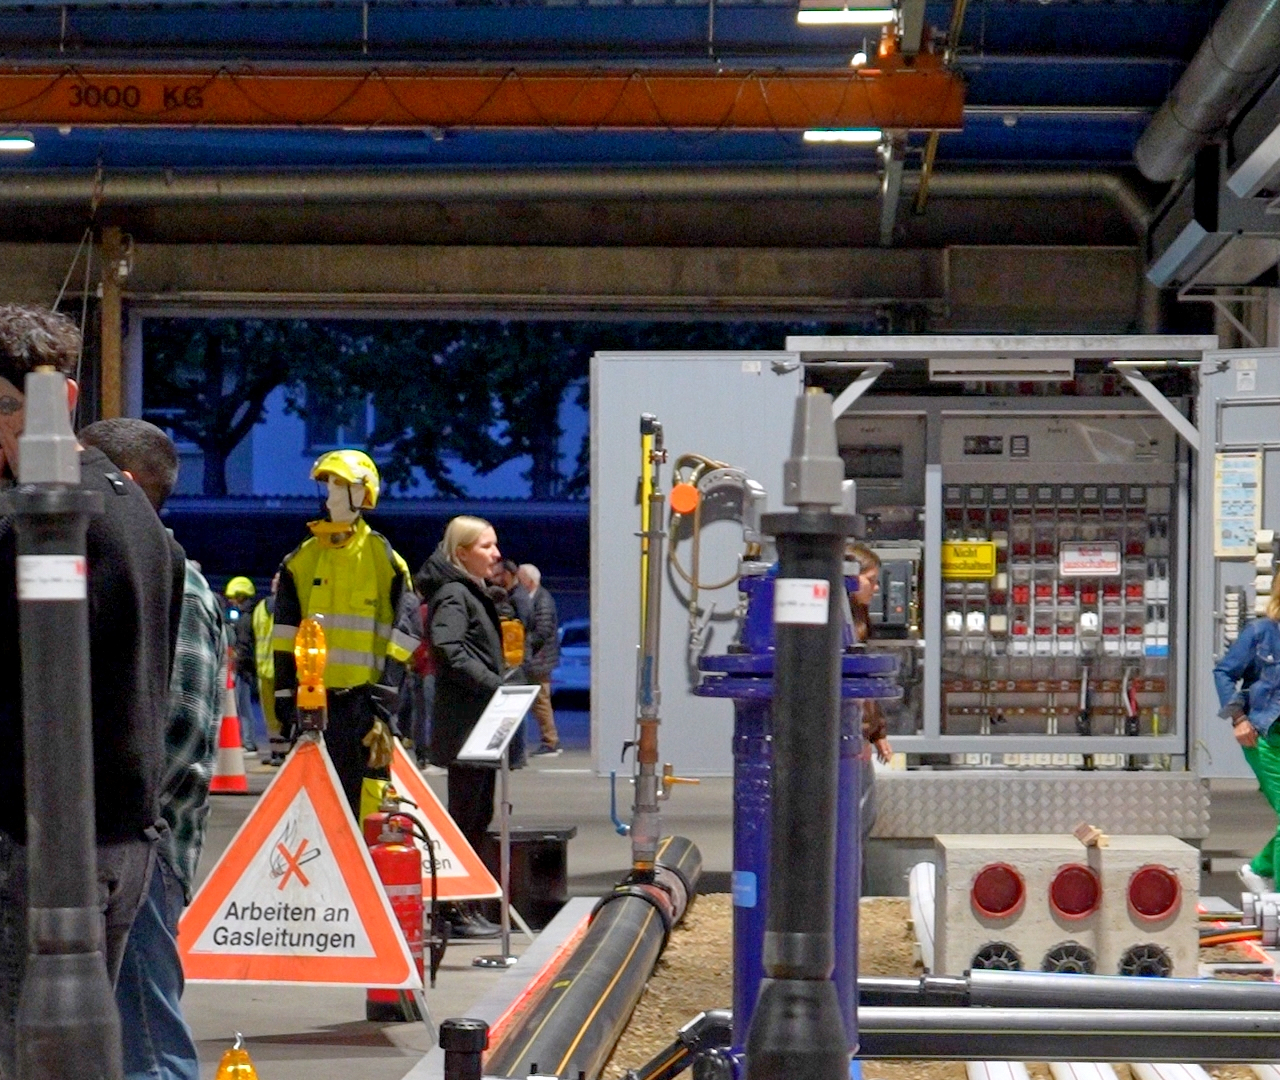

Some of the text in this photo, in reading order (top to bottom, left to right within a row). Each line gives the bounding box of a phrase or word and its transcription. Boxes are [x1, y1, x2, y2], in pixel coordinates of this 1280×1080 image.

[69, 85, 204, 109] 3000 KG
[953, 546, 978, 557] Nicht
[224, 901, 349, 922] Arbeiten an
[213, 926, 356, 953] Gasleitungen
